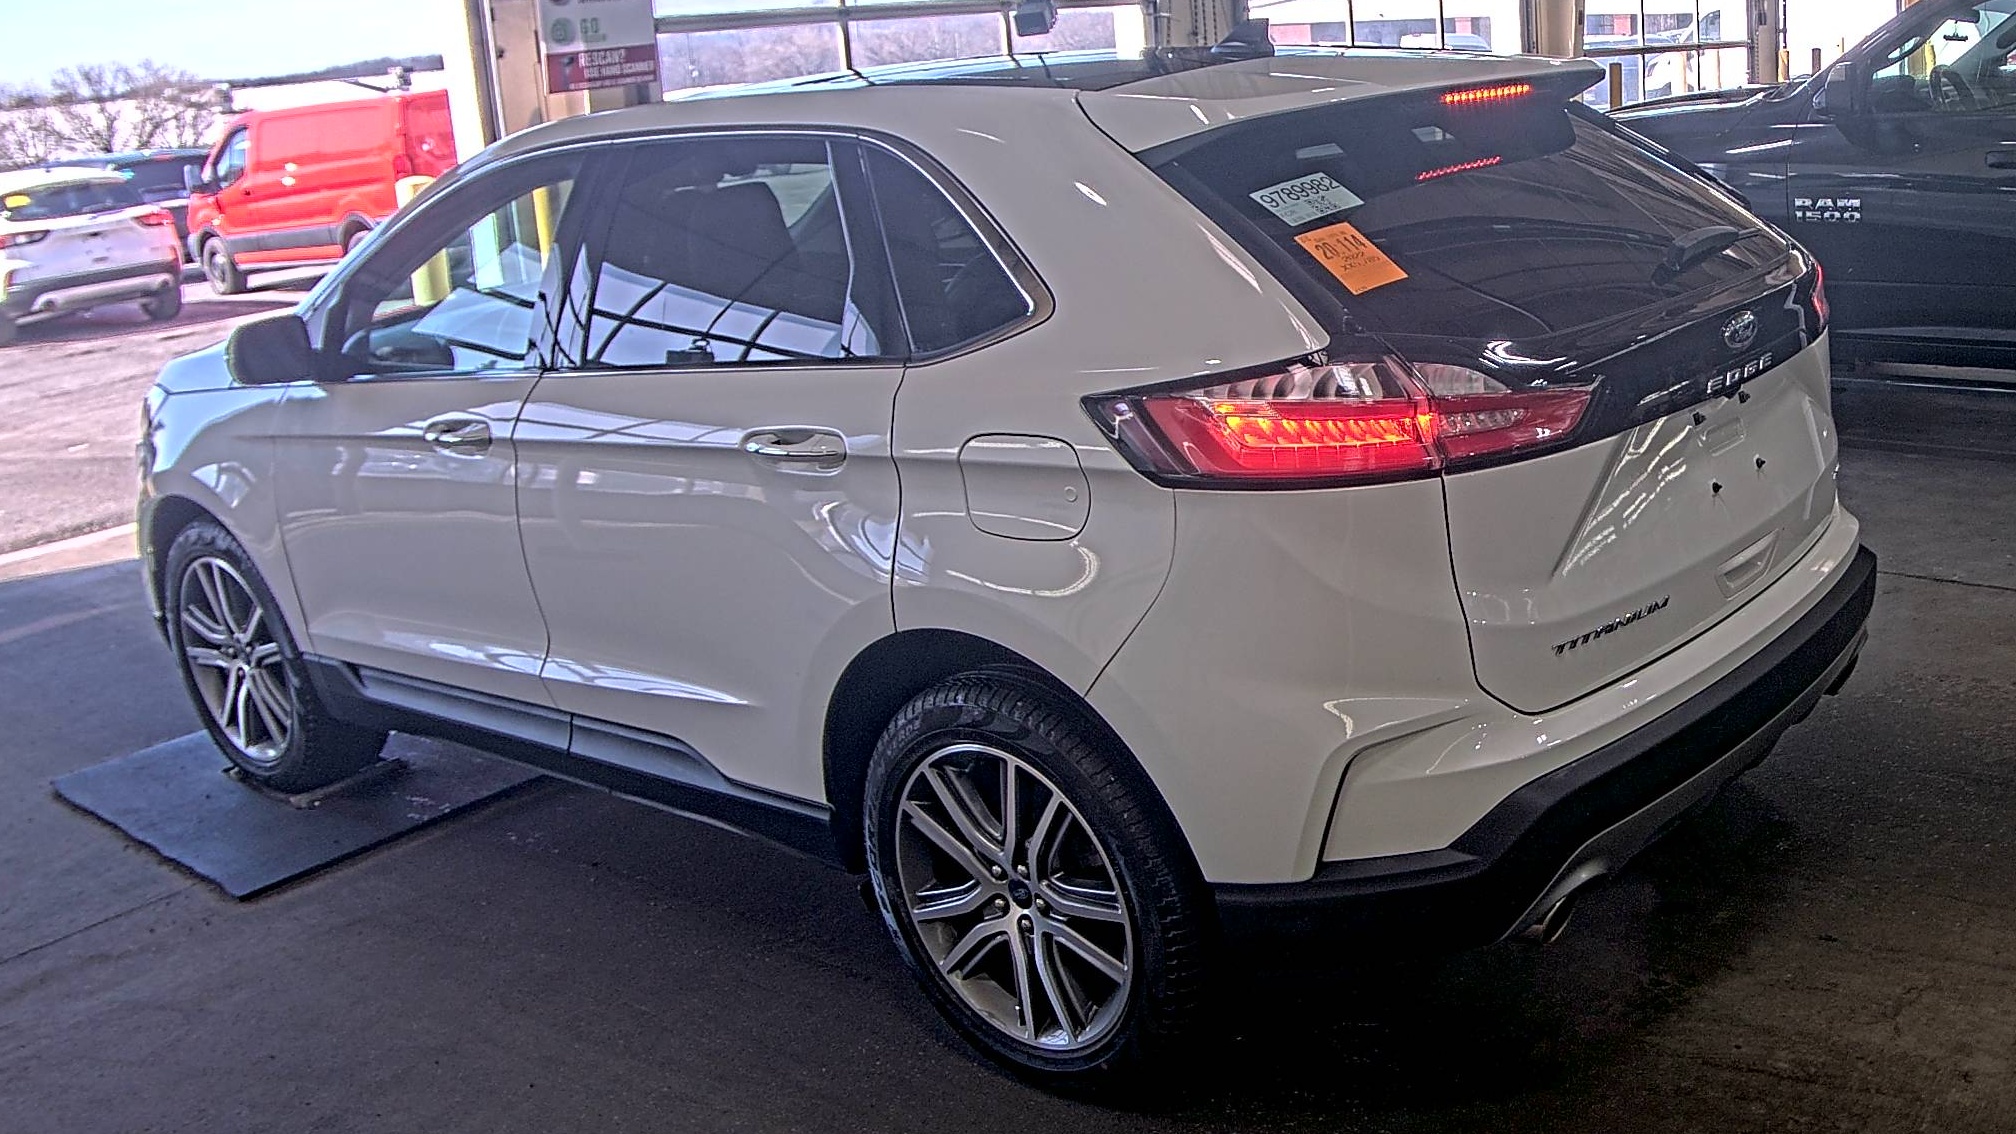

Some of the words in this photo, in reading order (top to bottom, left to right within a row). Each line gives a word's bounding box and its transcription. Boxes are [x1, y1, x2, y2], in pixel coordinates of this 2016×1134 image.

[580, 17, 599, 34] GO
[1260, 177, 1340, 208] 9789982
[1794, 197, 1861, 210] RAM
[1795, 210, 1861, 222] 1500
[1706, 352, 1773, 394] EDGE
[1551, 595, 1670, 656] TITANIUM
